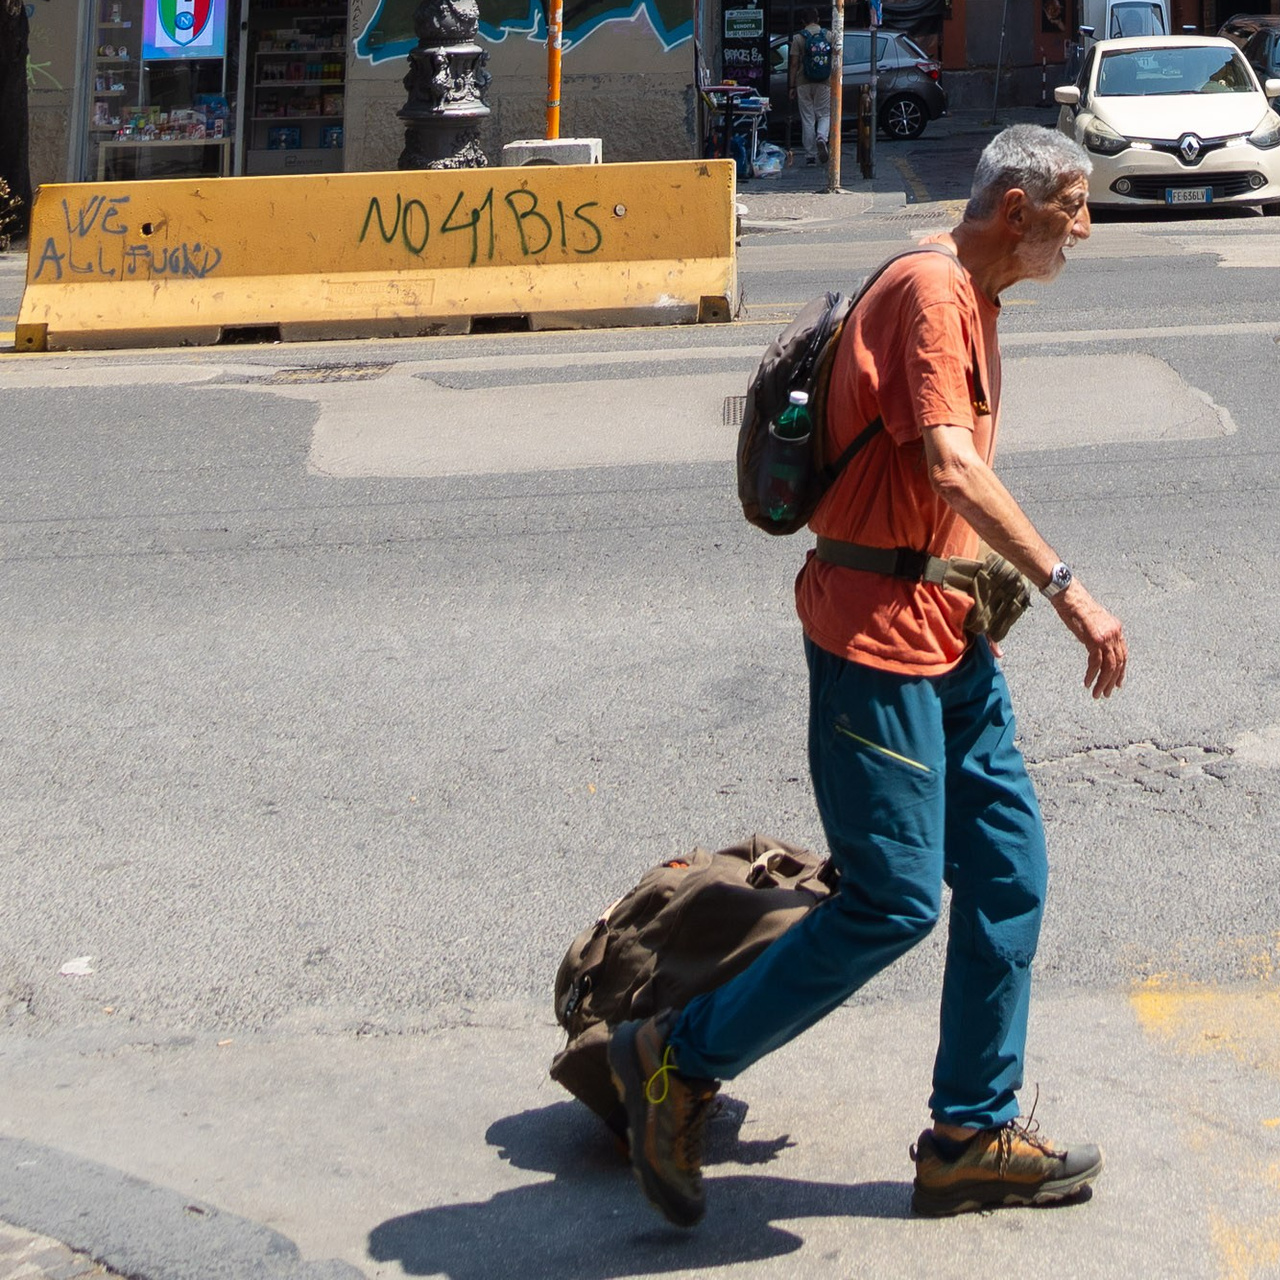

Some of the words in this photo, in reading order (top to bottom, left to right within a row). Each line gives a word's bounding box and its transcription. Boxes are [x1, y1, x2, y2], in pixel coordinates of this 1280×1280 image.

[62, 195, 131, 237] WE
[358, 192, 431, 256] NO
[34, 237, 116, 280] ALL
